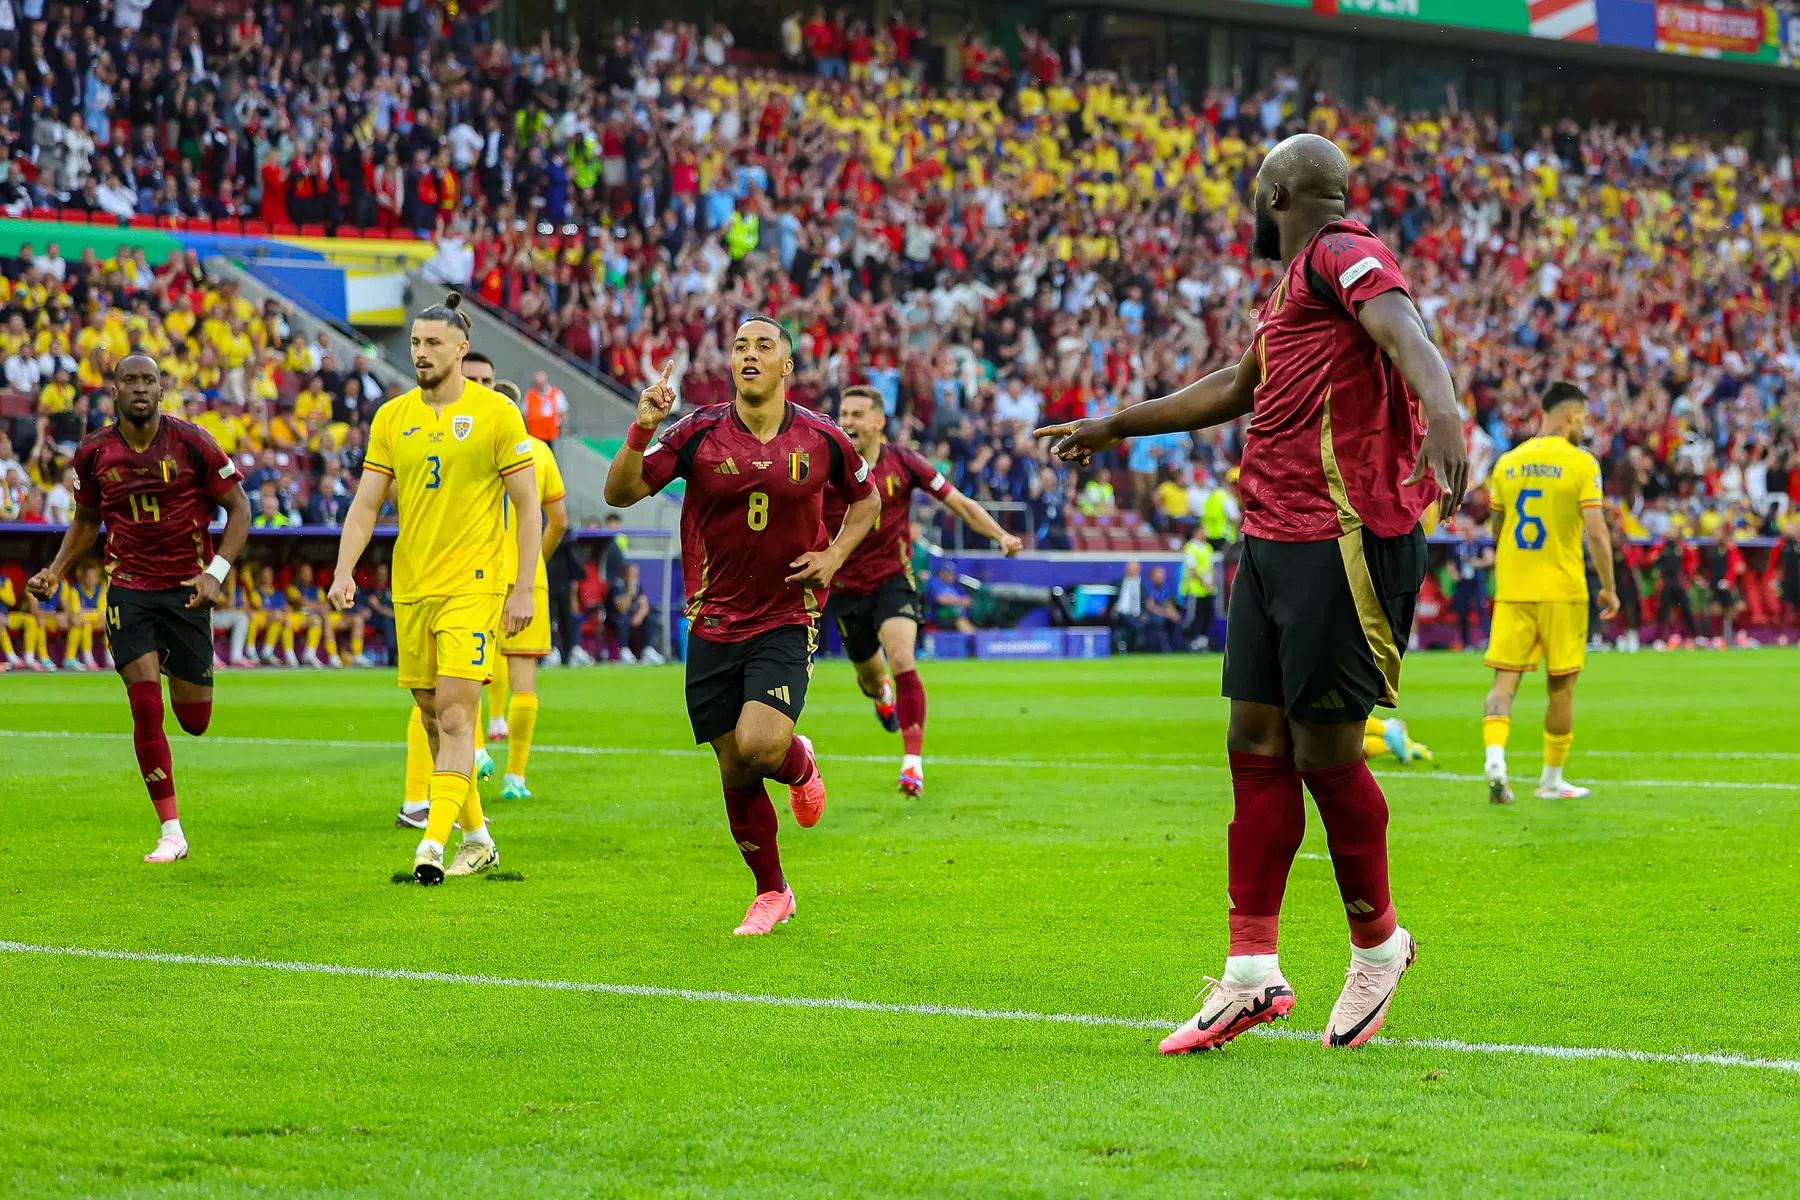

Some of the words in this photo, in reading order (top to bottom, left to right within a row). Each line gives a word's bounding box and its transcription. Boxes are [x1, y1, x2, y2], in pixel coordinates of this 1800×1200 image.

[426, 456, 440, 488] 3
[129, 494, 160, 522] 14
[748, 492, 769, 531] 8
[1515, 489, 1546, 549] 6
[472, 632, 486, 665] 3
